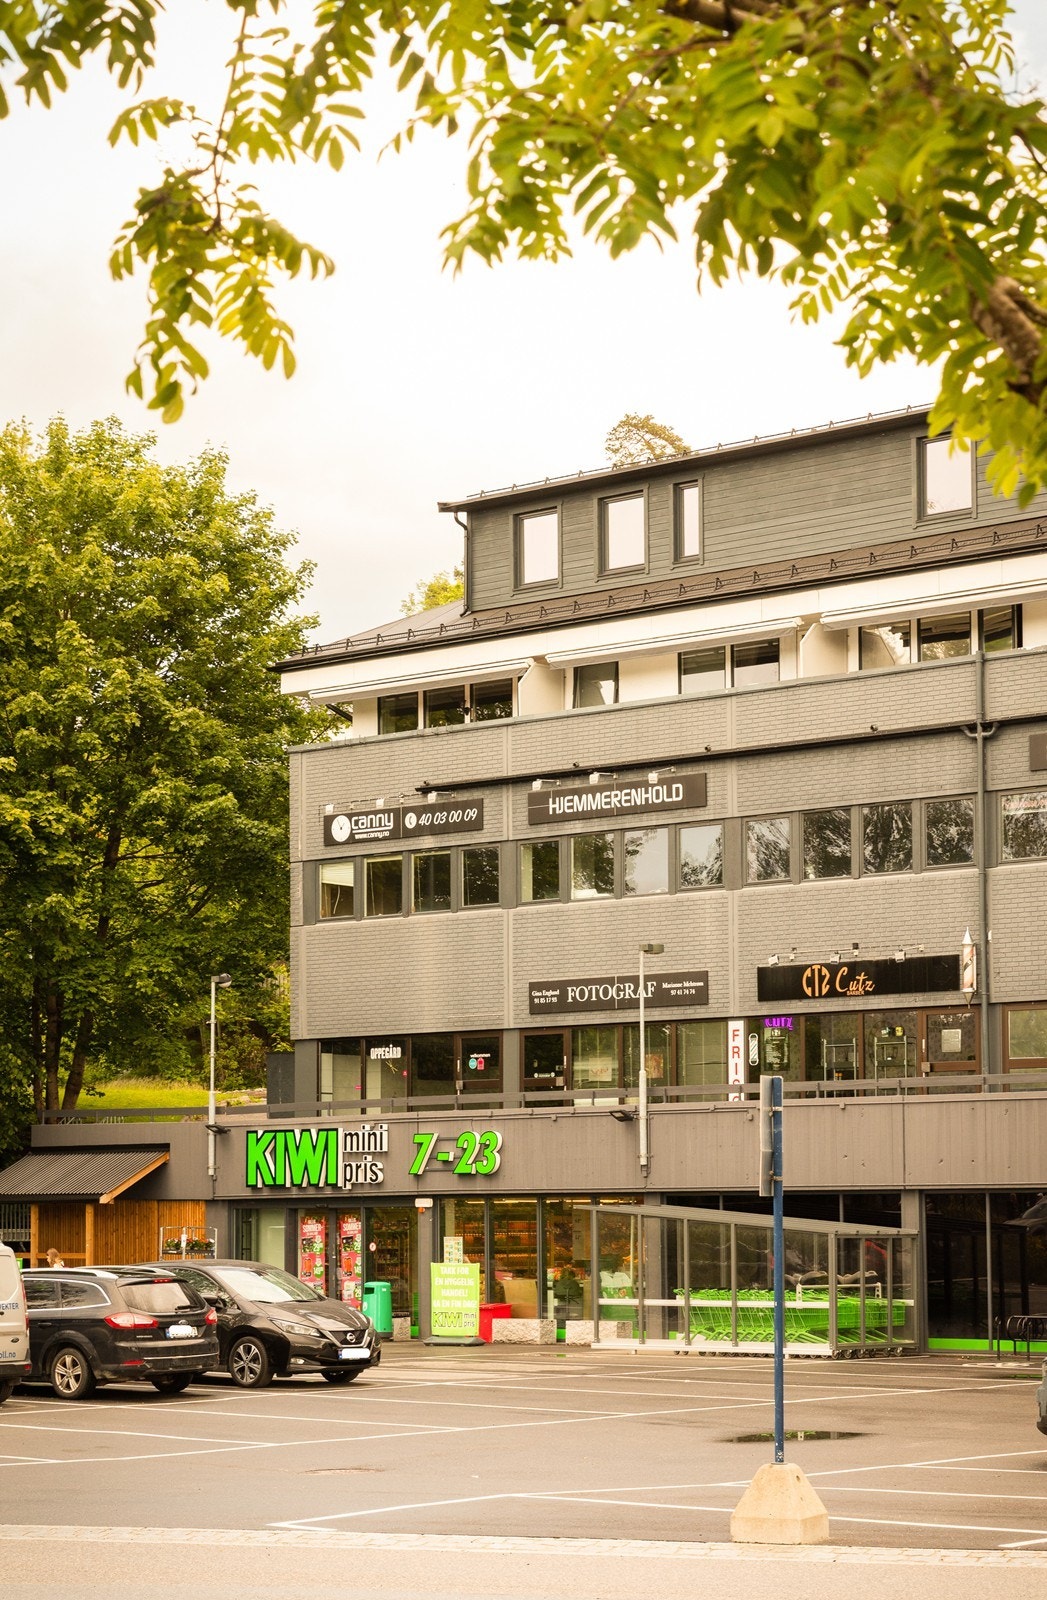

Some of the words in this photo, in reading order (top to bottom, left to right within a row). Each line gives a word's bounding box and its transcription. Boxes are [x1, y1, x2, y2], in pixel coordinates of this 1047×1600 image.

[549, 783, 683, 815] HJEMMERENHOLD
[351, 812, 393, 831] canny
[419, 813, 432, 826] 40
[433, 811, 446, 825] 03
[448, 810, 462, 824] 00
[464, 808, 478, 821] 09
[835, 966, 875, 992] Cutz
[566, 981, 657, 1003] FOTOGRAF
[370, 1044, 402, 1059] OPPEGÅRD
[343, 1124, 388, 1152] mini
[246, 1128, 340, 1188] KIWI
[342, 1155, 384, 1189] pris
[433, 1311, 463, 1328] KIWI
